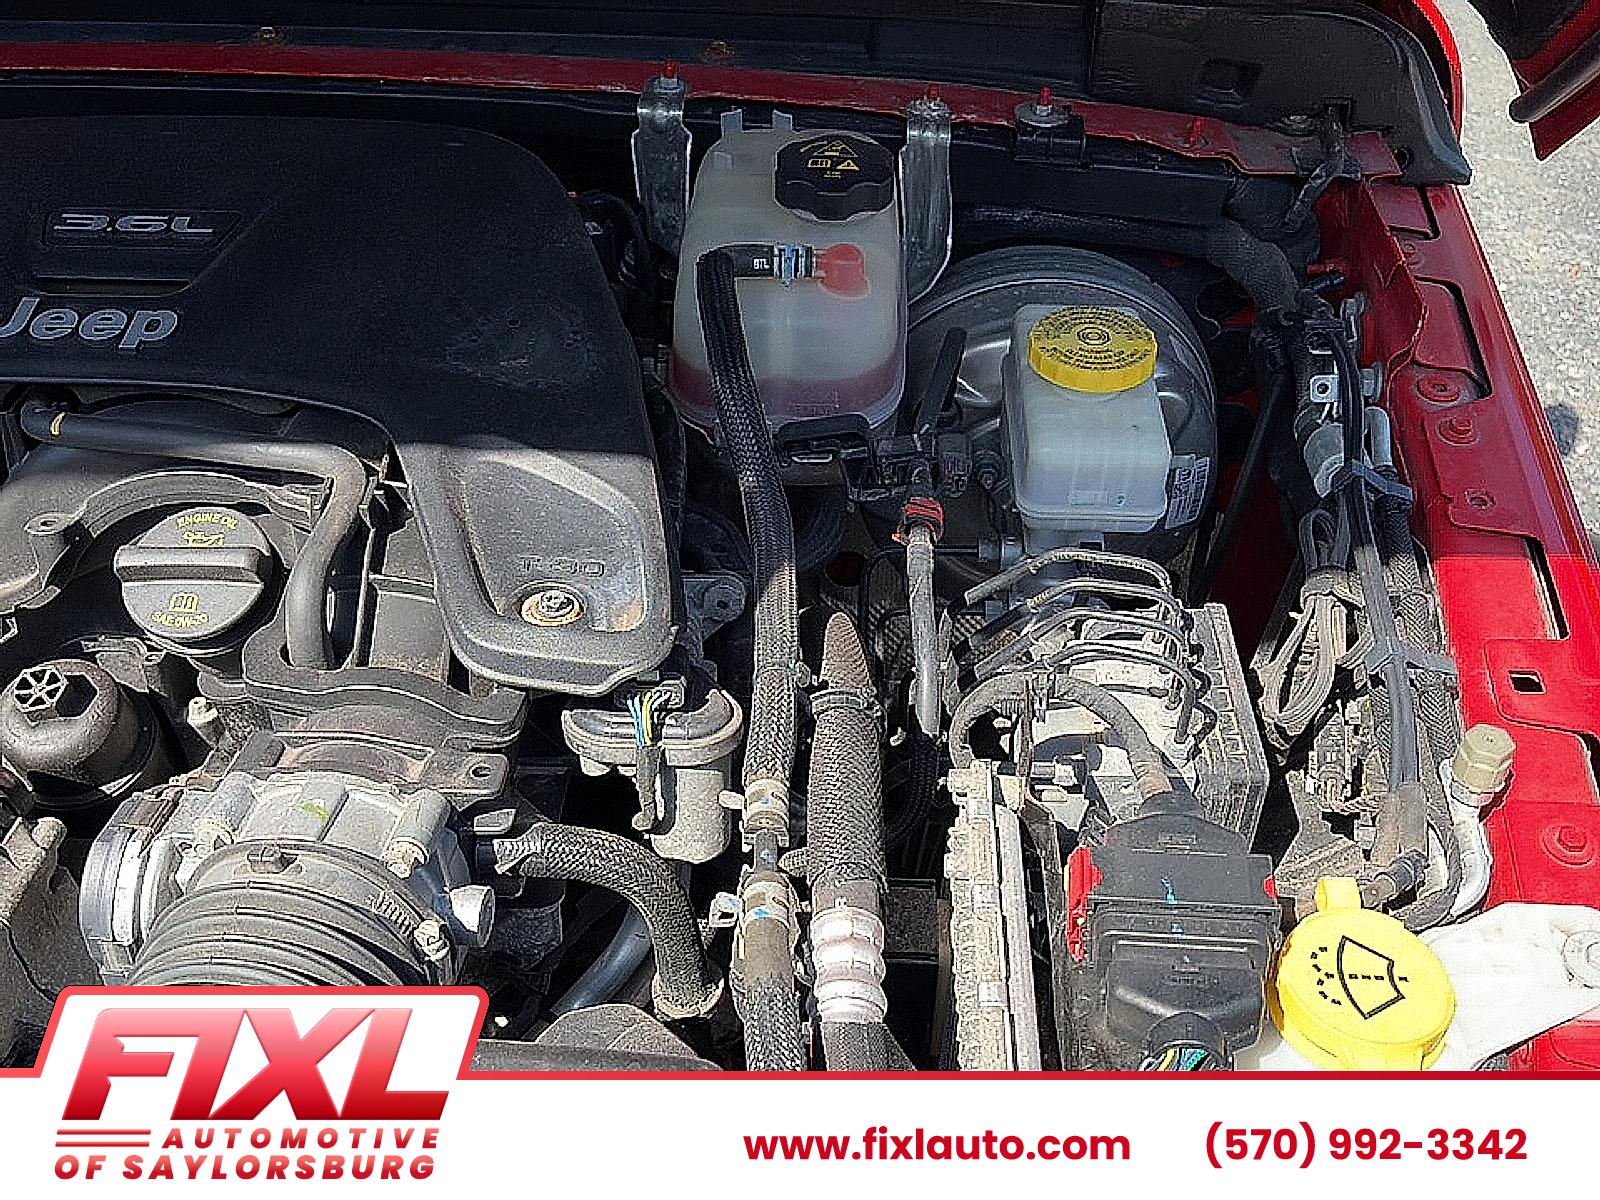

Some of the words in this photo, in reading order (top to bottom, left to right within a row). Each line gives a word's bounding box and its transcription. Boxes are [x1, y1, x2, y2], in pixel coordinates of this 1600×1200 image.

[54, 213, 213, 233] 3.6L
[0, 296, 178, 349] Jeep
[176, 512, 221, 528] ENGINE
[221, 515, 239, 530] OIL
[151, 611, 175, 628] SAE
